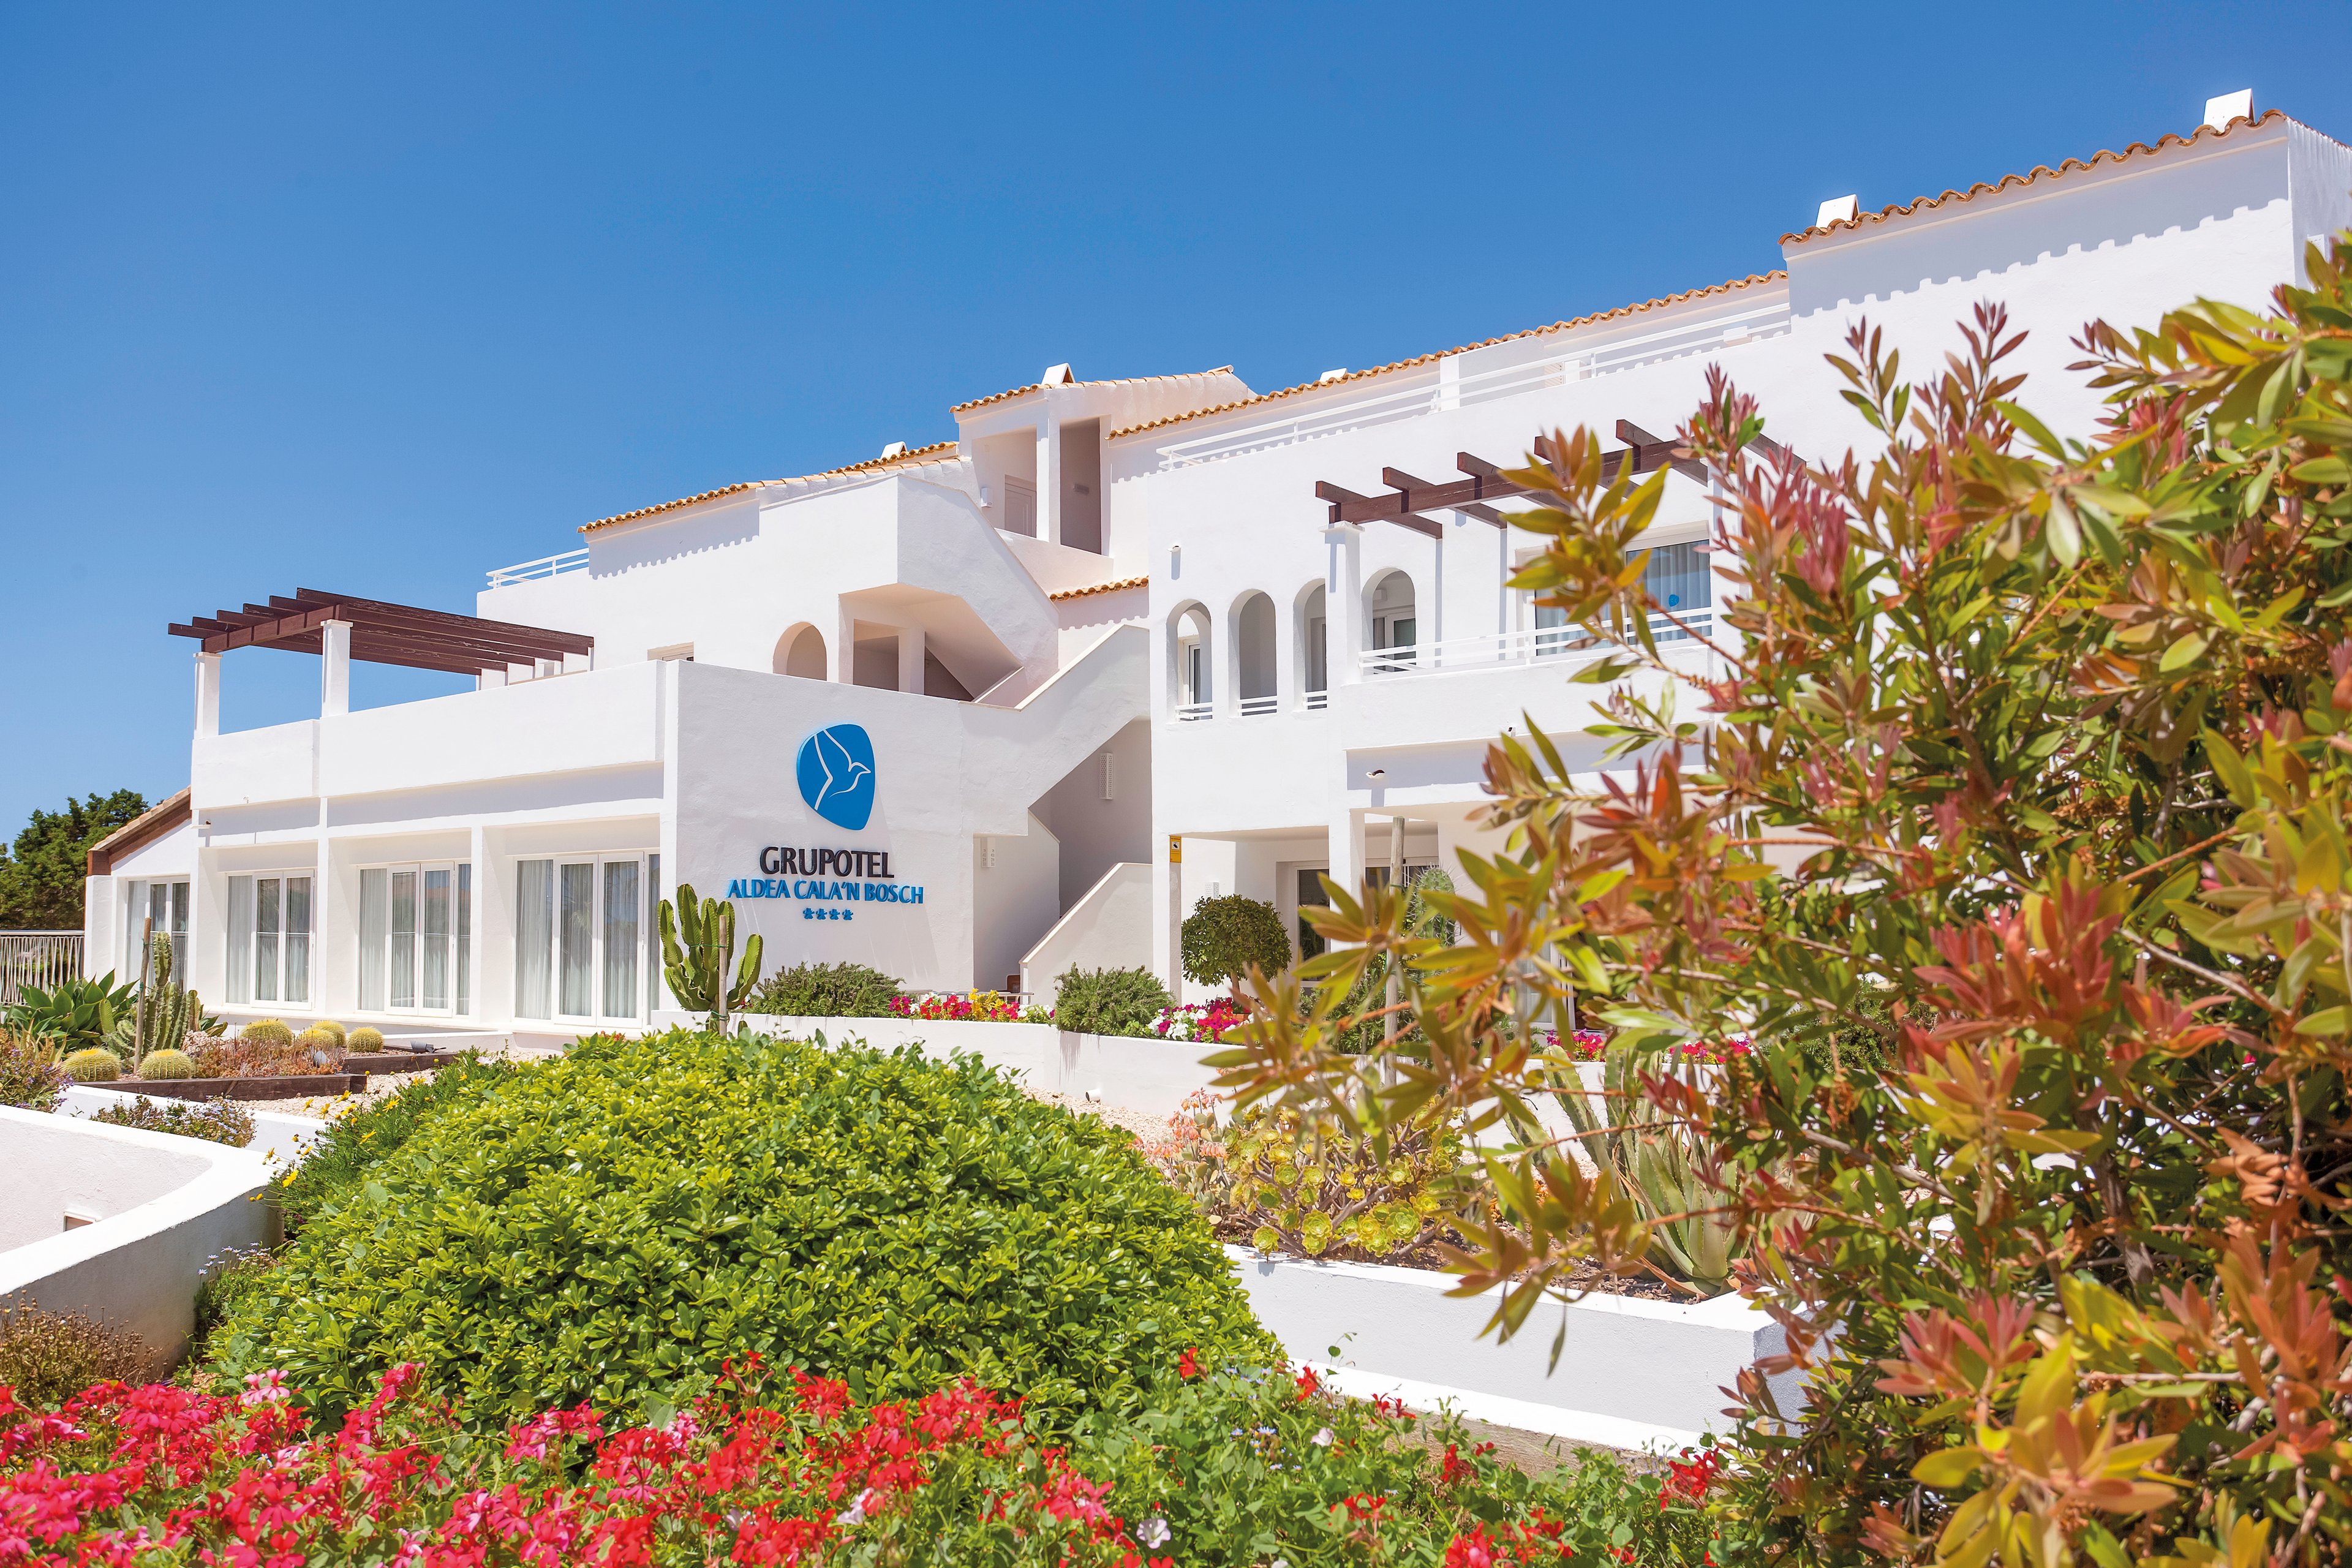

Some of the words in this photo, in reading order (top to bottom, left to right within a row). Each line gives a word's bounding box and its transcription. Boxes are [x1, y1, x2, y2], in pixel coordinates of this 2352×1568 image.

[760, 846, 894, 878] GRUPOTEL
[726, 879, 791, 899] ALDEA
[864, 883, 924, 904] BOSCH
